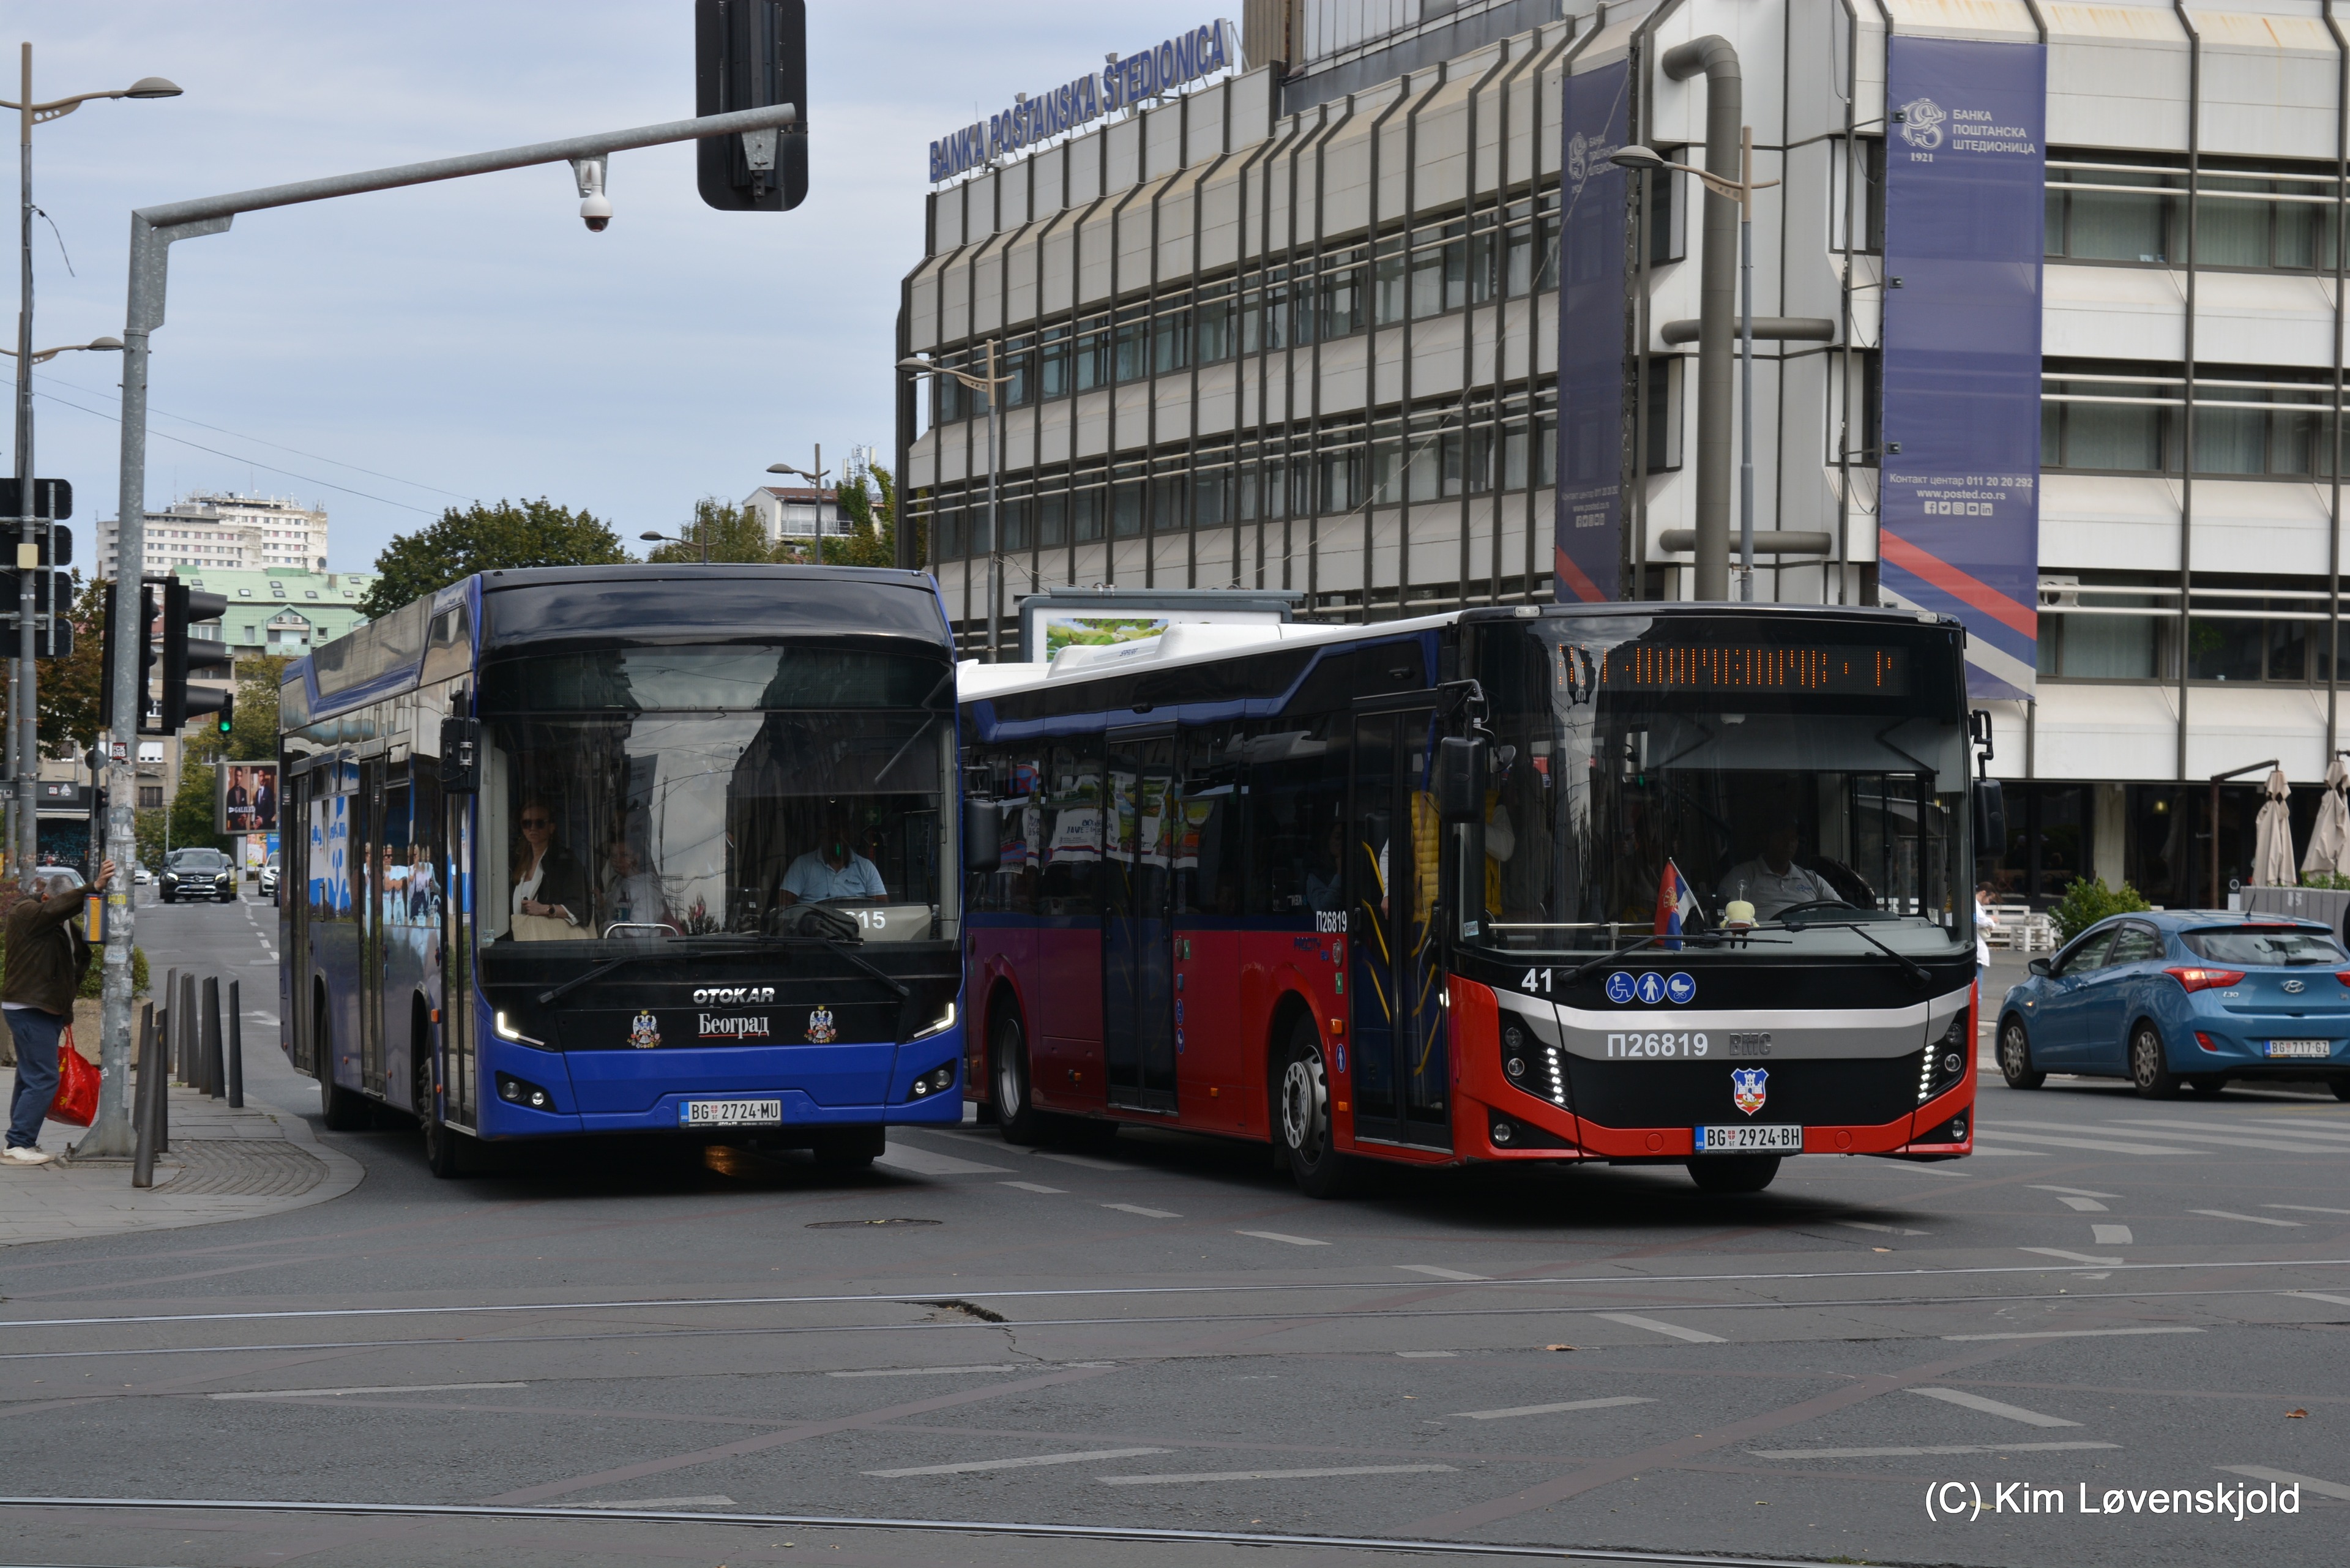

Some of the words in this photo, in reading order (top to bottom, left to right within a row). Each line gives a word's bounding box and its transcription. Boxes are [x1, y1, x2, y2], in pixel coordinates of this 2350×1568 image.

[930, 121, 989, 182] BANKA
[990, 72, 1102, 159] POŠTANSKA
[1103, 18, 1230, 112] ŠTEDIONICA
[1953, 109, 1993, 122] БАНКА
[1953, 124, 2027, 138] ПОШТАНСКА
[1953, 140, 2036, 155] ШТЕДИОНИЦА
[1910, 152, 1934, 162] 1921
[1889, 473, 1928, 484] Контакт
[1930, 476, 1964, 487] центар
[1966, 476, 1983, 486] 011
[1986, 477, 1999, 487] 20
[2001, 477, 2013, 487] 20
[2015, 477, 2033, 488] 292
[1916, 490, 2006, 500] www.posted.co.rs
[845, 911, 886, 930] 15
[1316, 910, 1347, 933] П26819
[1521, 968, 1551, 993] 41
[693, 987, 775, 1004] OTOKAR
[698, 1014, 769, 1039] Београд
[1607, 1033, 1709, 1057] П26819
[1729, 1032, 1772, 1056] BMC
[2272, 1042, 2285, 1053] BG
[692, 1104, 709, 1120] BG
[1707, 1129, 1726, 1146] BG
